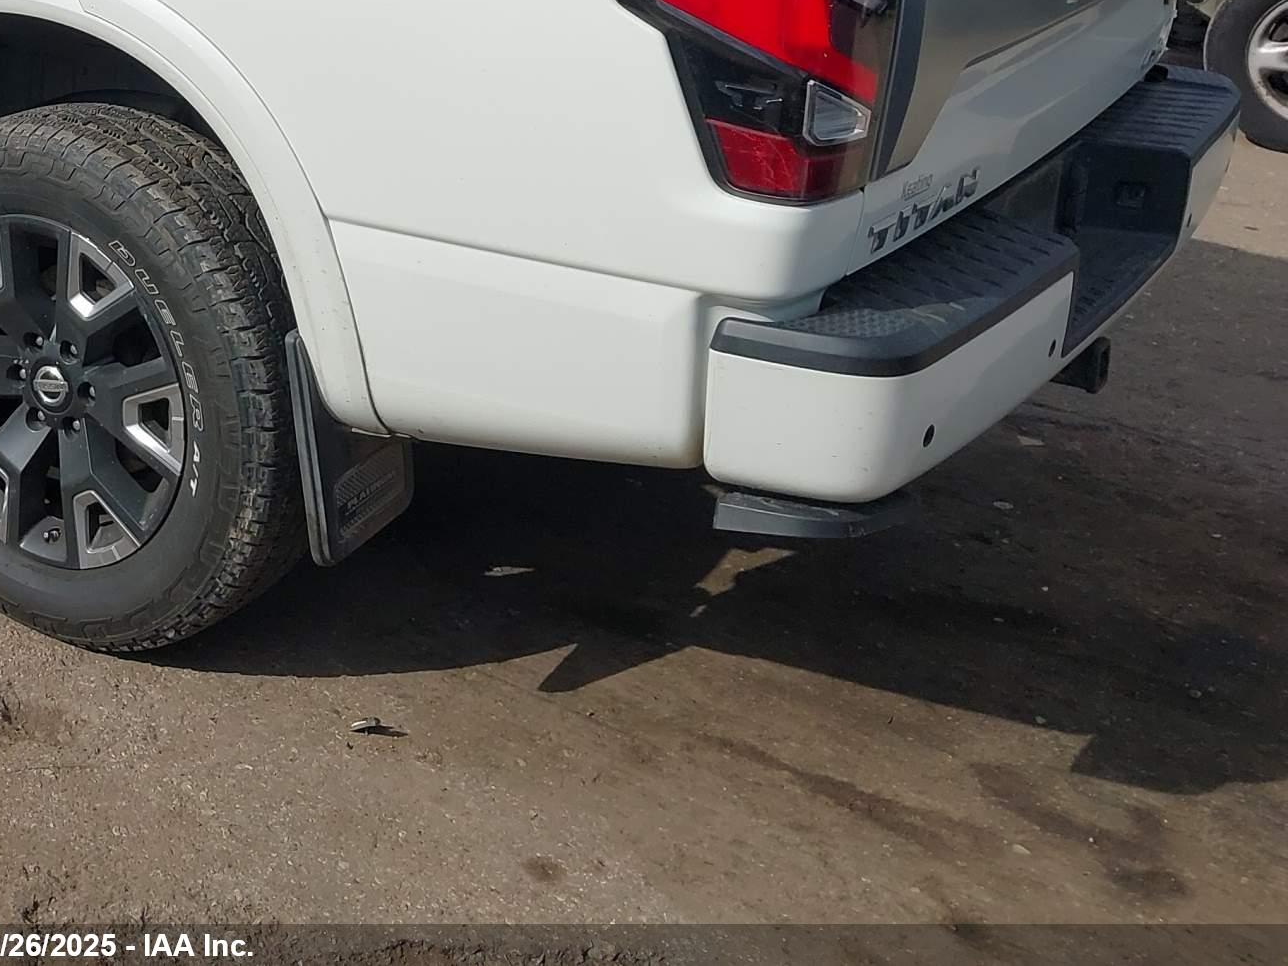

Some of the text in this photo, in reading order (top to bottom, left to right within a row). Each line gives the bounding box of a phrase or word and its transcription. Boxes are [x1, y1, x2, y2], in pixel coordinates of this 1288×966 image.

[868, 168, 979, 254] TITAN
[109, 240, 204, 498] DUELER A/T
